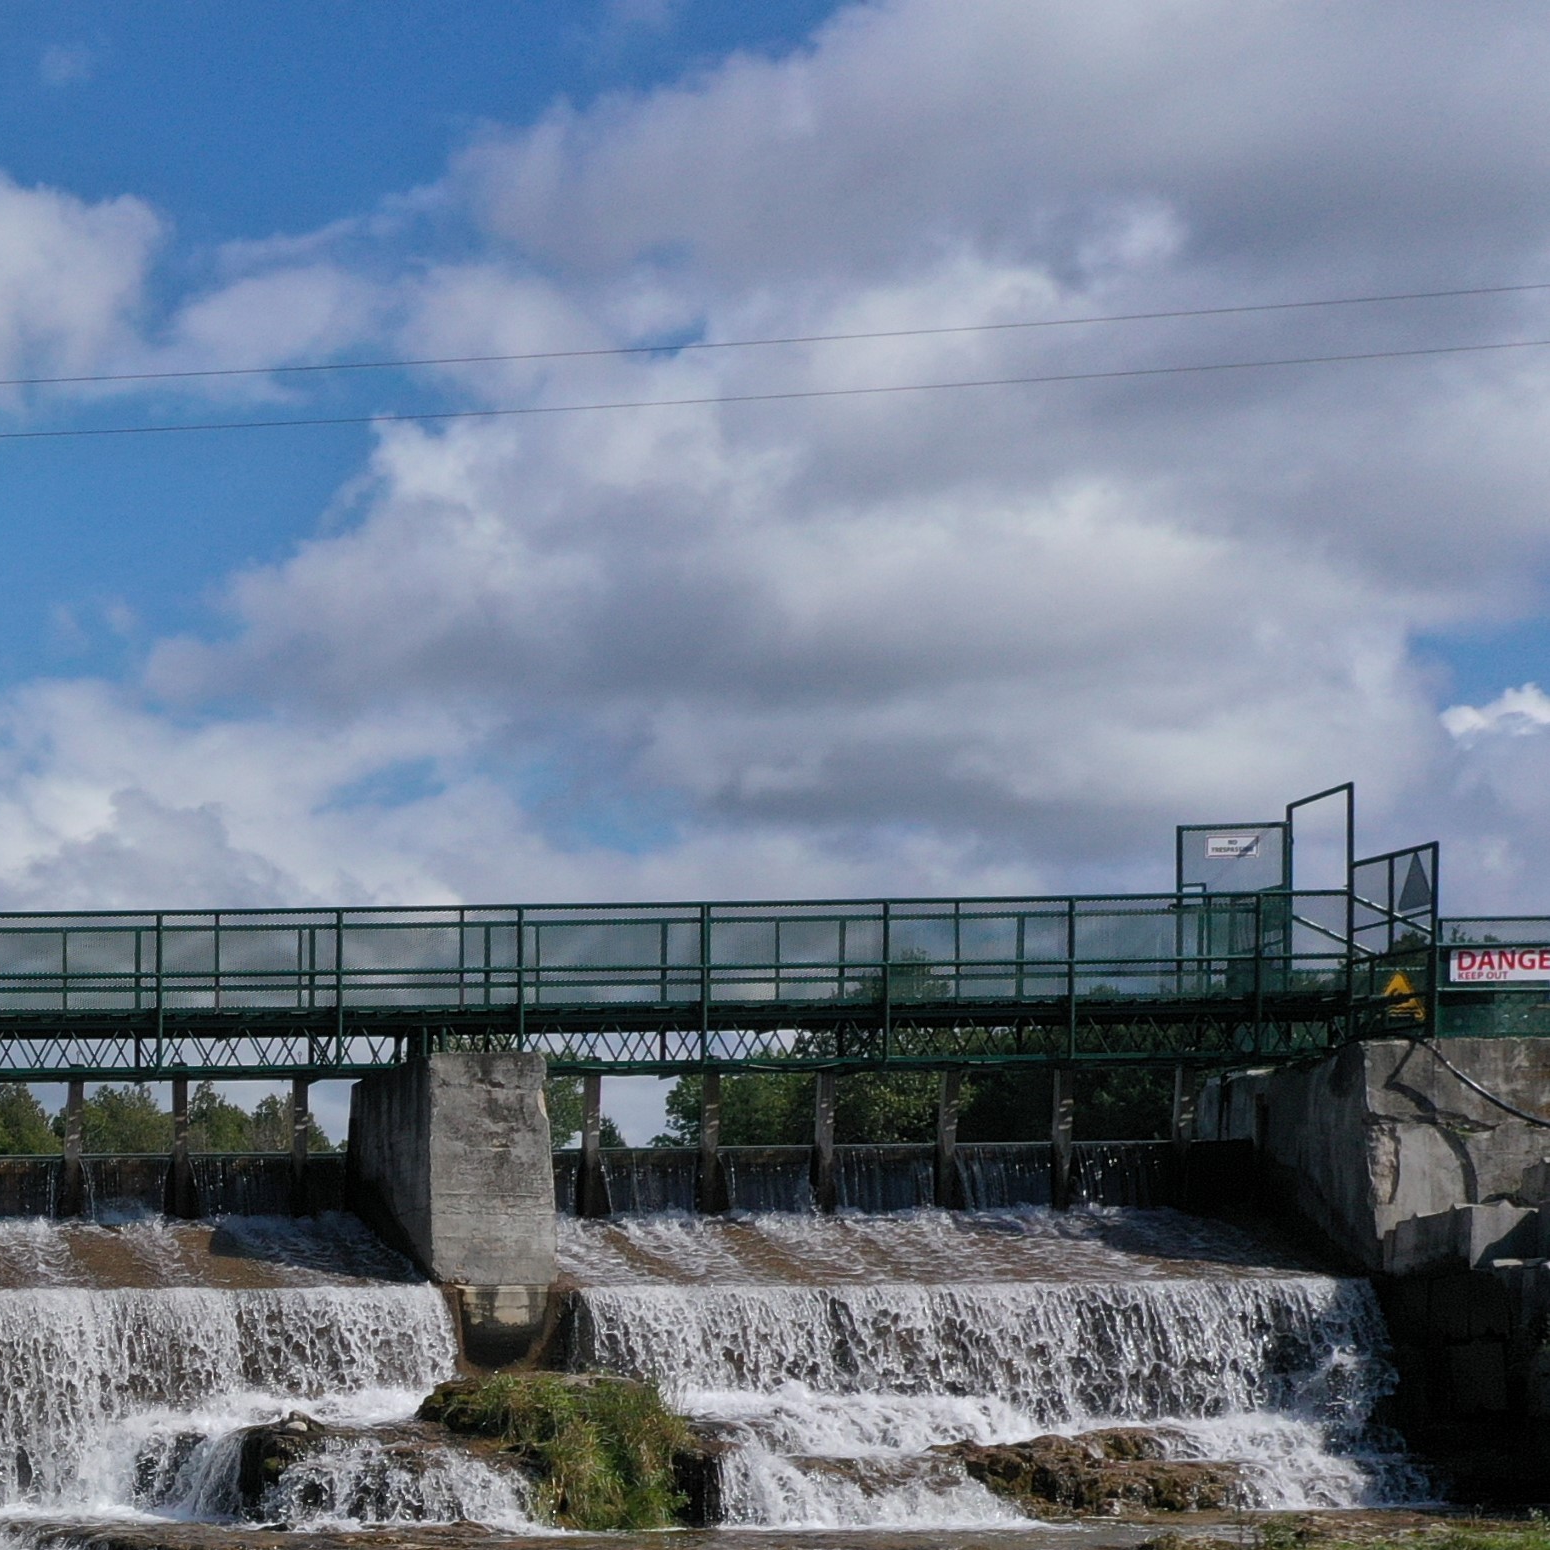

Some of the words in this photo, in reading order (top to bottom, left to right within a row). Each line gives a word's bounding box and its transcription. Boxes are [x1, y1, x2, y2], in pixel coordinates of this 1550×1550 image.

[1457, 950, 1550, 971] DANGE
[1458, 971, 1484, 980] KEEP
[1486, 971, 1509, 979] OUT
